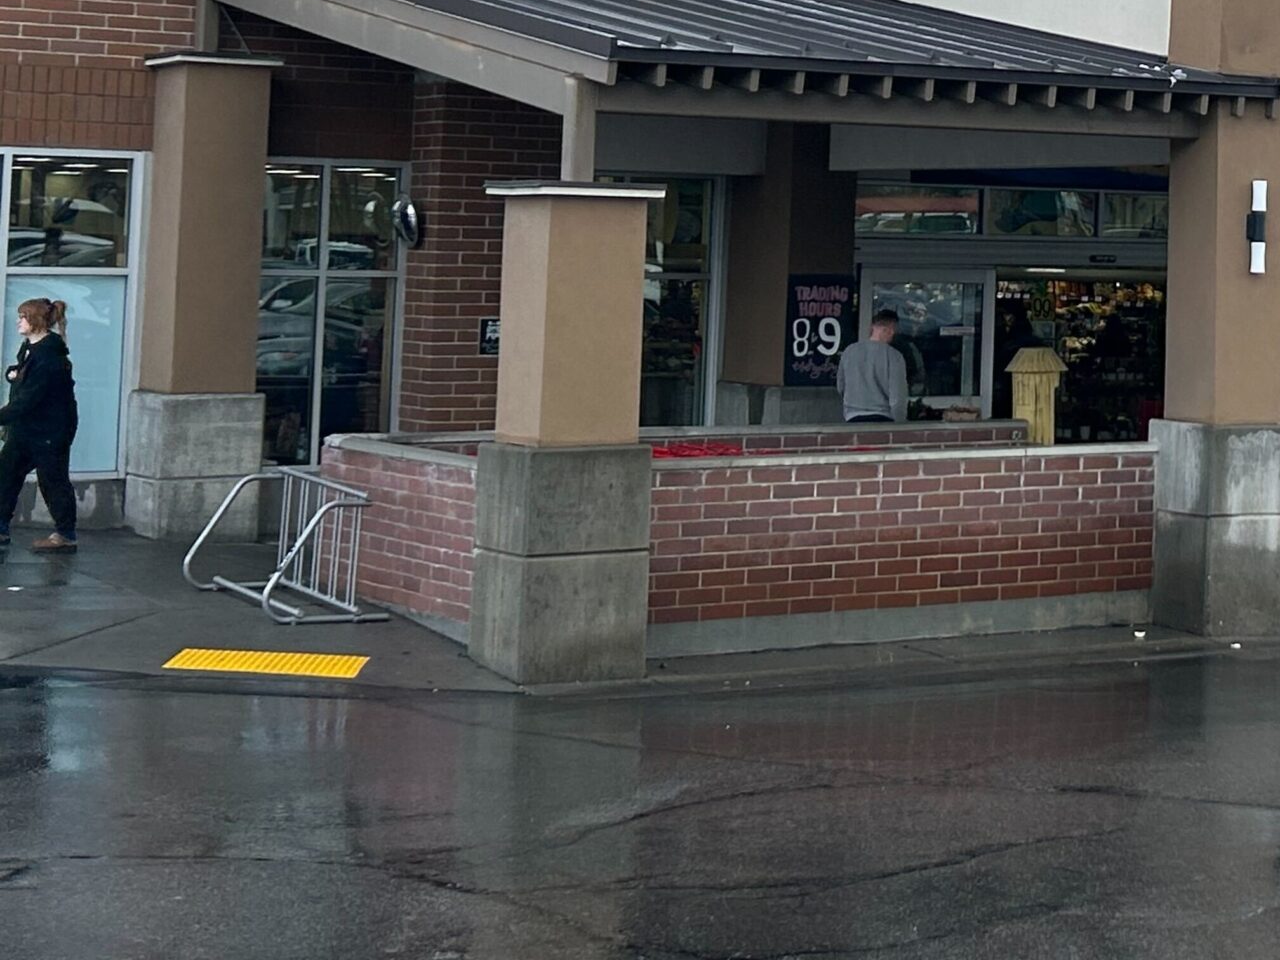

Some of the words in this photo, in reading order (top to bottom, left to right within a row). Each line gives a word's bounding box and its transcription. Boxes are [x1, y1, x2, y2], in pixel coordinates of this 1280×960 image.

[794, 285, 849, 303] TRADING
[798, 301, 842, 317] HOURS
[792, 318, 811, 357] 8
[817, 317, 841, 356] 9
